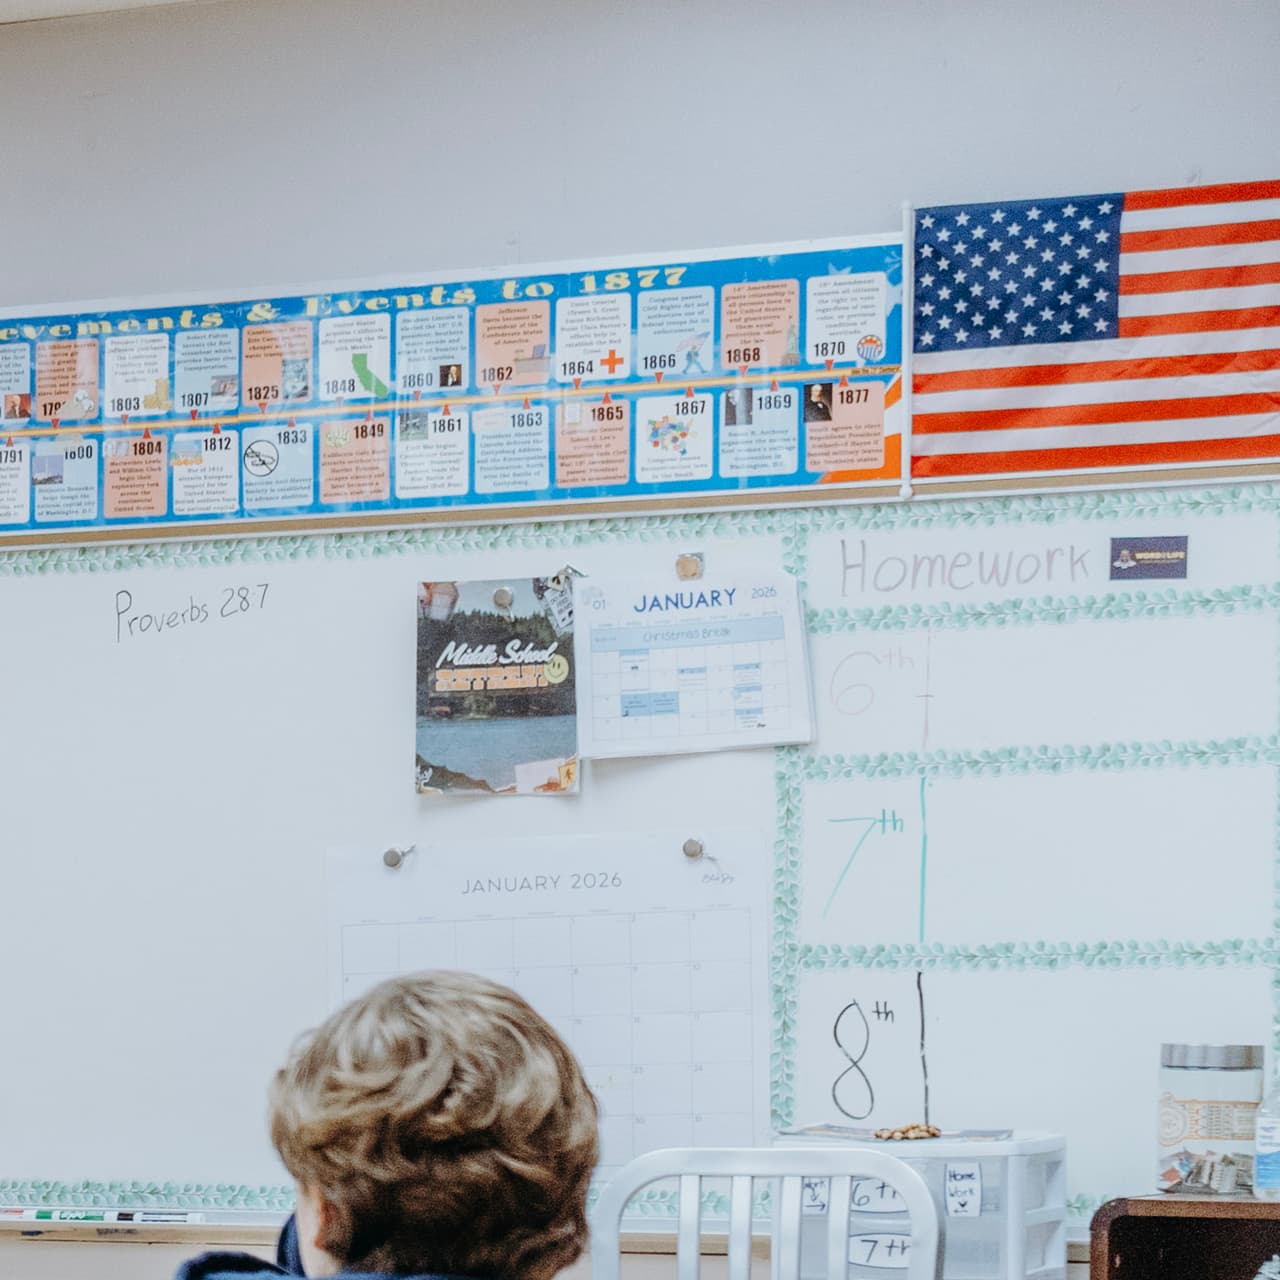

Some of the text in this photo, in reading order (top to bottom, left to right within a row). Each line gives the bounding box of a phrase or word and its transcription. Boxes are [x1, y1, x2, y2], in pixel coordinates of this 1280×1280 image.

[246, 302, 280, 322] &
[305, 285, 477, 317] Events
[502, 279, 554, 300] to
[579, 266, 688, 293] 1877
[726, 348, 760, 363] 1868
[814, 341, 845, 356] 1870
[562, 360, 594, 375] 1864
[643, 354, 676, 369] 1866
[402, 373, 433, 388] 1860
[482, 366, 513, 381] 1862
[248, 386, 279, 400] 1825
[325, 379, 355, 393] 1848
[111, 398, 140, 411] 1803
[181, 392, 208, 407] 1807
[758, 395, 792, 410] 1869
[839, 390, 869, 404] 1877
[43, 401, 66, 416] 179
[591, 407, 623, 422] 1865
[675, 400, 705, 415] 1867
[431, 418, 462, 433] 1861
[511, 412, 543, 427] 1863
[277, 430, 307, 445] 1833
[354, 424, 384, 439] 1849
[133, 441, 162, 456] 1804
[204, 436, 231, 451] 1812
[64, 446, 92, 460] 1800
[840, 539, 1091, 598] Homework
[633, 587, 737, 613] JANUARY
[751, 585, 777, 600] 2026
[114, 589, 210, 643] Proverbs
[642, 626, 700, 643] Christmas
[435, 638, 559, 668] Middle School
[829, 645, 916, 717] 6th
[823, 808, 905, 920] 7th
[461, 871, 623, 895] JANUARY 2026
[831, 997, 895, 1121] 8th
[948, 1169, 976, 1182] Home
